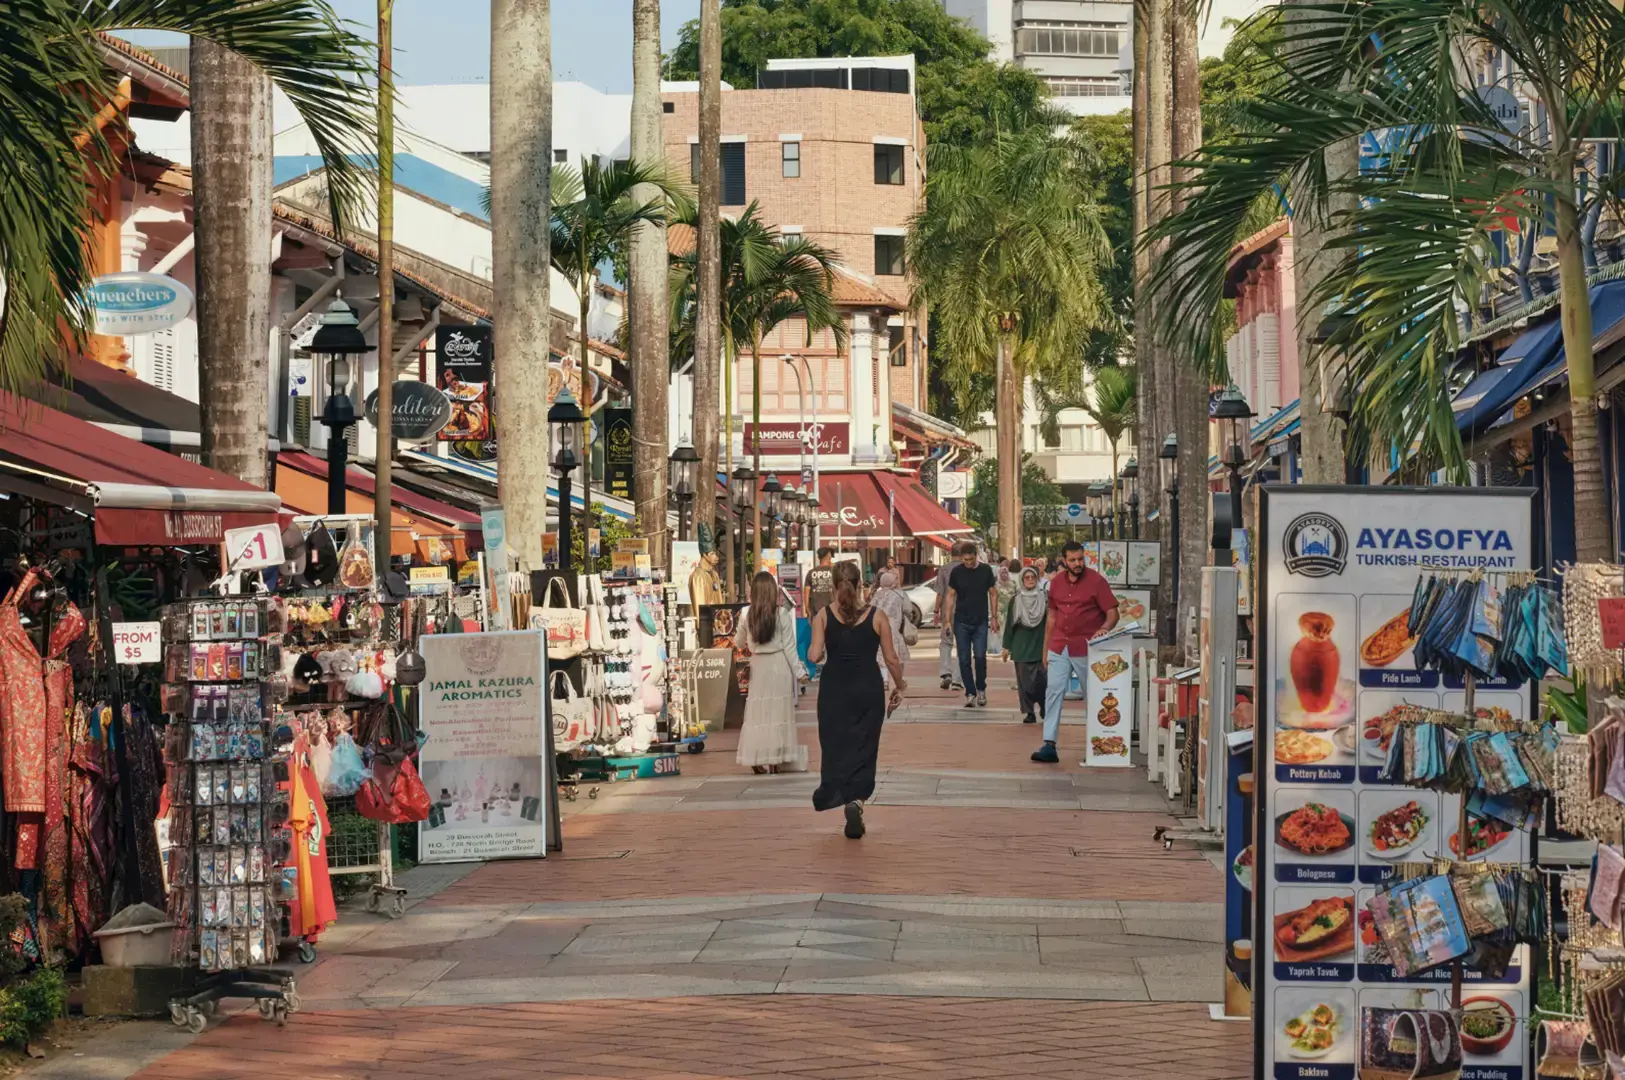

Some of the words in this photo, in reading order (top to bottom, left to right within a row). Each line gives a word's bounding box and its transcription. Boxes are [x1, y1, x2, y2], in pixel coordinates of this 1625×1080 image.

[752, 431, 794, 439] AMPONG
[1356, 528, 1513, 550] AYASOFYA
[1356, 554, 1418, 566] TURKISH
[1422, 555, 1516, 568] RESTAURANT
[114, 632, 152, 644] FROM
[124, 646, 142, 659] $5
[699, 659, 704, 668] A
[698, 670, 702, 679] A
[704, 670, 722, 678] CUP.
[1382, 673, 1398, 684] Pide
[1400, 674, 1421, 684] Lamb
[430, 680, 472, 692] JAMAL
[478, 676, 534, 688] KAZURA
[441, 689, 522, 701] AROMATICS
[1290, 769, 1317, 780] Pottery
[1318, 769, 1342, 779] Kebab
[1297, 868, 1336, 880] Bolognese
[1288, 967, 1314, 978] Yaprak
[1316, 967, 1339, 977] Tavuk
[1435, 969, 1452, 978] Rice
[1463, 970, 1482, 978] Town
[1298, 1068, 1329, 1077] Baklava
[1476, 1070, 1508, 1080] Pudding
